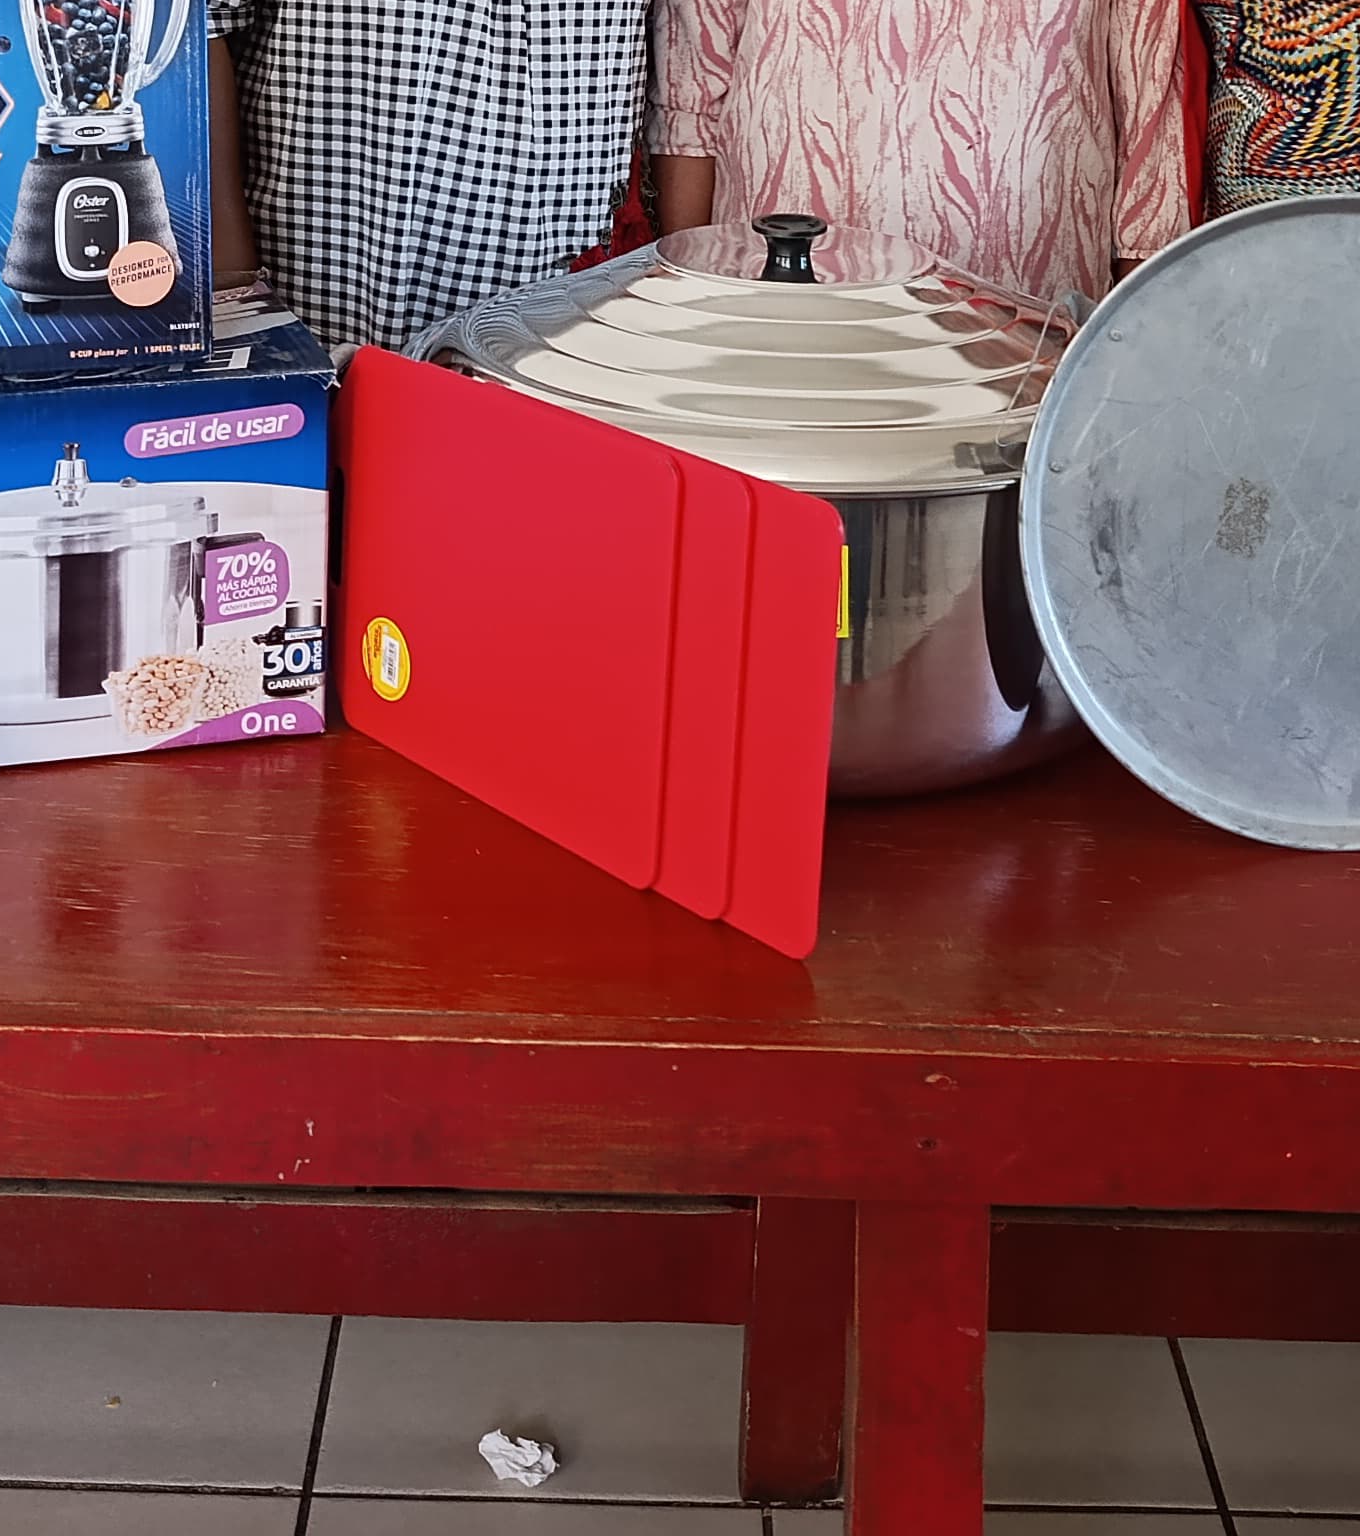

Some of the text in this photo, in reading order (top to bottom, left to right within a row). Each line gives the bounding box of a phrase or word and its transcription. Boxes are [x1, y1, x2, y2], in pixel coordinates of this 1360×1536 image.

[73, 193, 110, 210] Oster
[110, 264, 172, 287] PERFORMANCE
[111, 258, 154, 277] DESIGNED
[140, 413, 290, 452] Fácil de usar
[216, 548, 276, 581] 70%
[216, 573, 278, 594] MÁS RÁPIDA
[217, 583, 278, 603] AL COCINAR
[263, 642, 311, 676] 30
[310, 639, 323, 671] años
[241, 711, 297, 735] One
